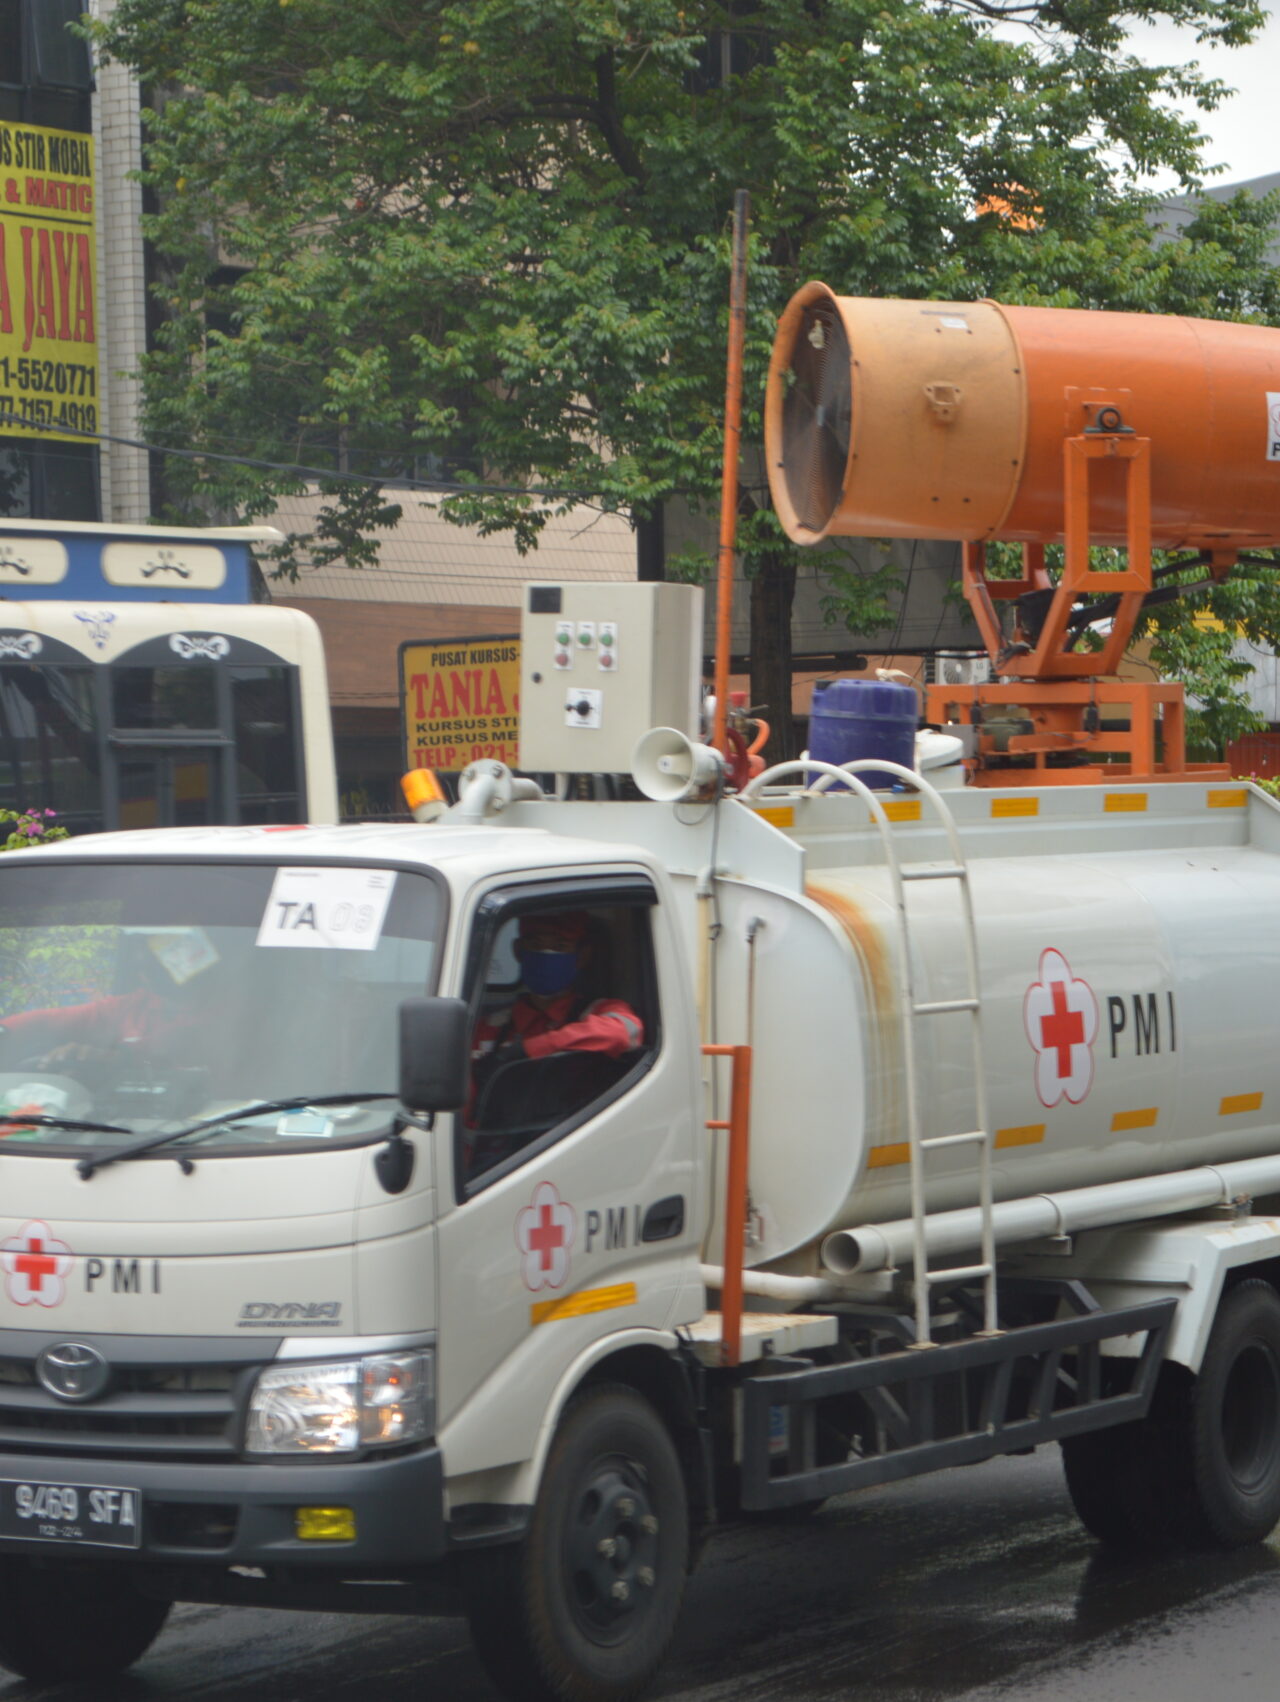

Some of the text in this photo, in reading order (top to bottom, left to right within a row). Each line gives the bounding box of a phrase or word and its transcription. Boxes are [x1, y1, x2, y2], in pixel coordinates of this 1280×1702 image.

[15, 130, 46, 172] STIR
[48, 135, 91, 177] MOBIL
[25, 176, 92, 213] MATIC
[20, 226, 95, 352] JAYA
[431, 650, 467, 668] PUSAT
[410, 668, 507, 720] TANIA
[416, 719, 487, 733] KURSUS
[417, 732, 488, 747] KURSUS
[413, 747, 457, 768] TELP
[276, 901, 317, 930] TA
[1106, 991, 1177, 1059] PMI
[584, 1204, 642, 1253] PMI
[83, 1257, 161, 1294] PMI
[240, 1302, 342, 1319] DYNA
[15, 1484, 136, 1526] 9469 SFA
